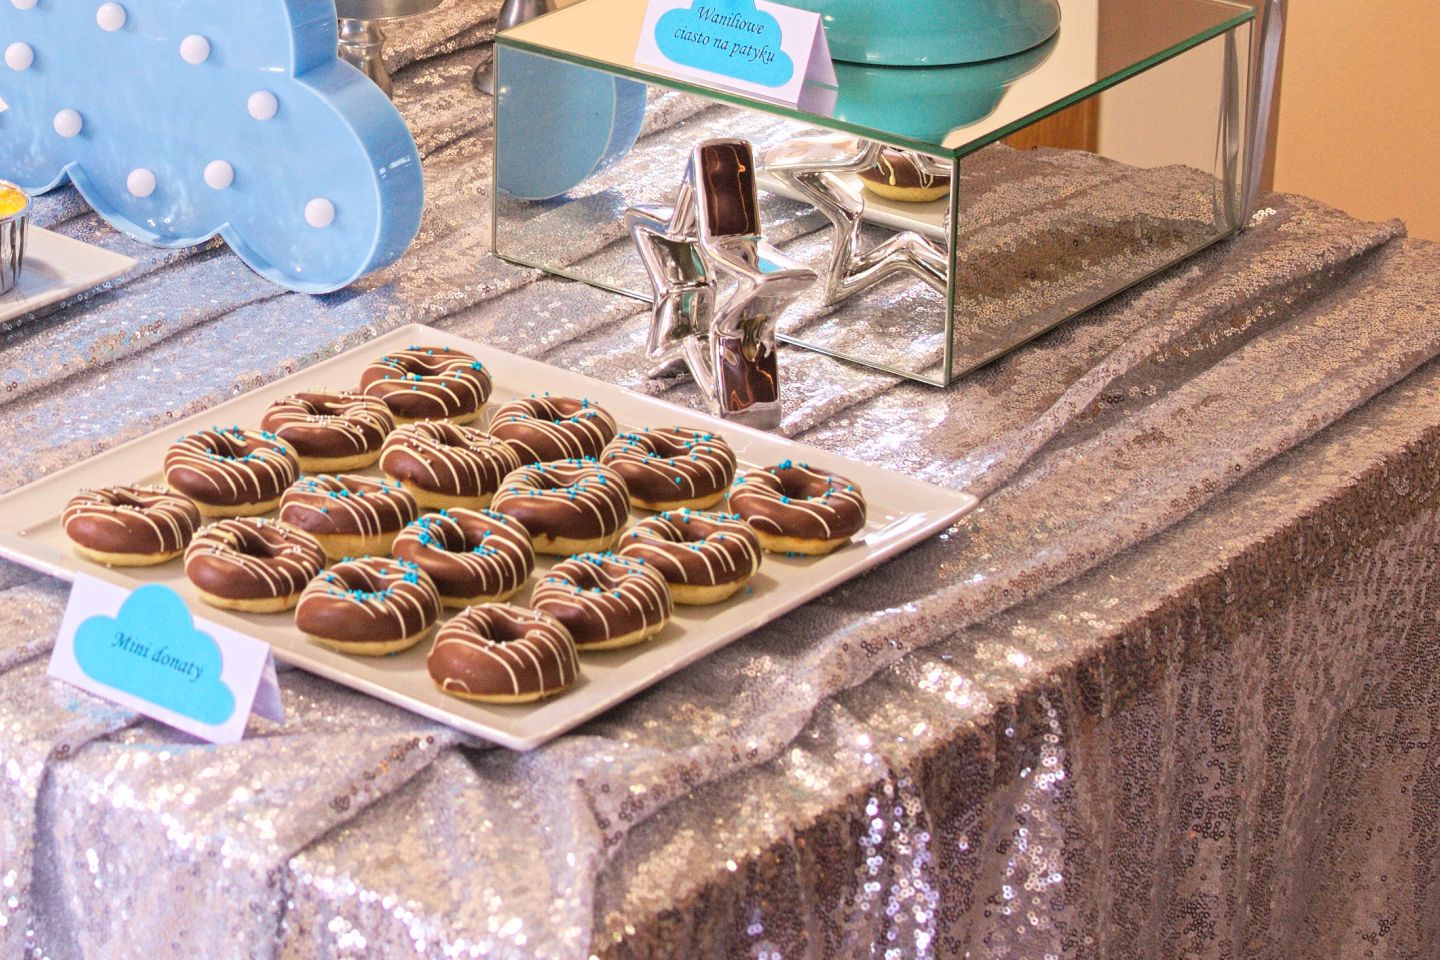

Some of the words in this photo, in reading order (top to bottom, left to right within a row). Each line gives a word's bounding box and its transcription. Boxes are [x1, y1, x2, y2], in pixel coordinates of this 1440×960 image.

[698, 6, 765, 35] Waniliowe
[674, 25, 710, 45] ciasto
[712, 35, 729, 51] na
[730, 42, 776, 65] patyku
[112, 631, 153, 659] Mini
[151, 645, 203, 683] donaty
